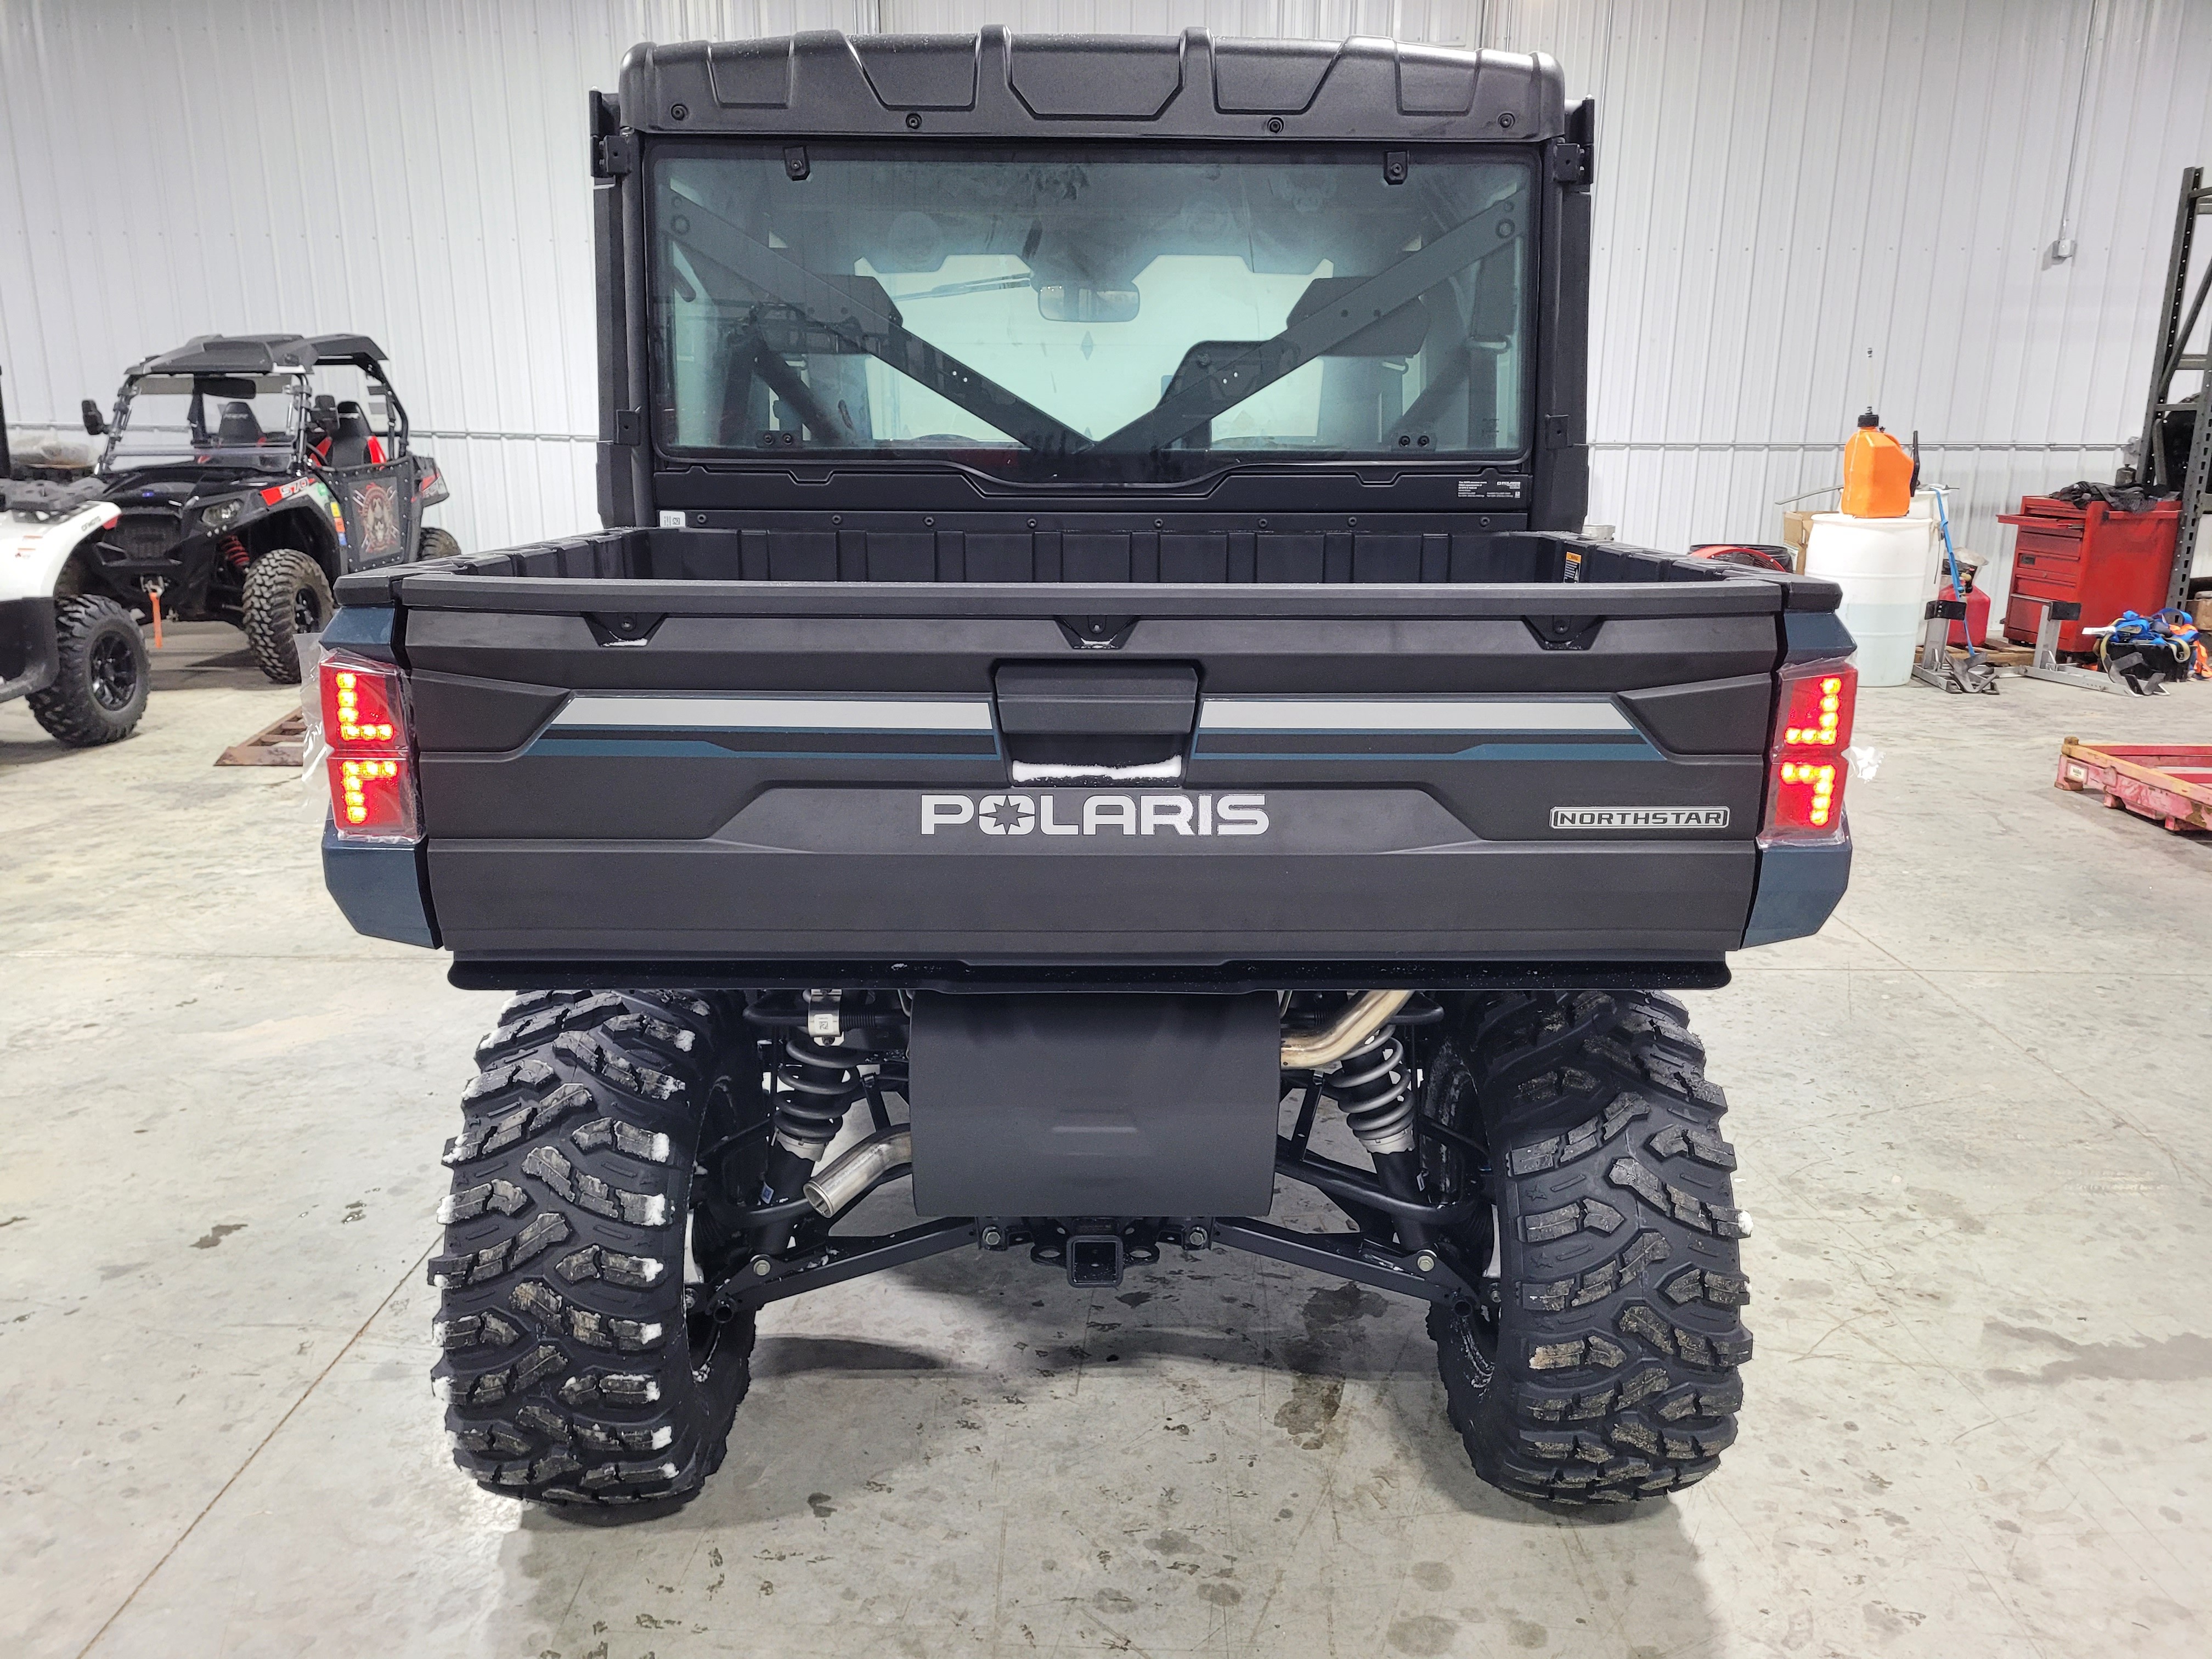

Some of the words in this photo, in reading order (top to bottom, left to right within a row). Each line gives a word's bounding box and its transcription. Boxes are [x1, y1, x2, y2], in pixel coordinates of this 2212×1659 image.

[281, 479, 308, 496] 570
[921, 794, 1270, 835] POLARIS
[1559, 812, 1722, 825] NORTHSTAR
